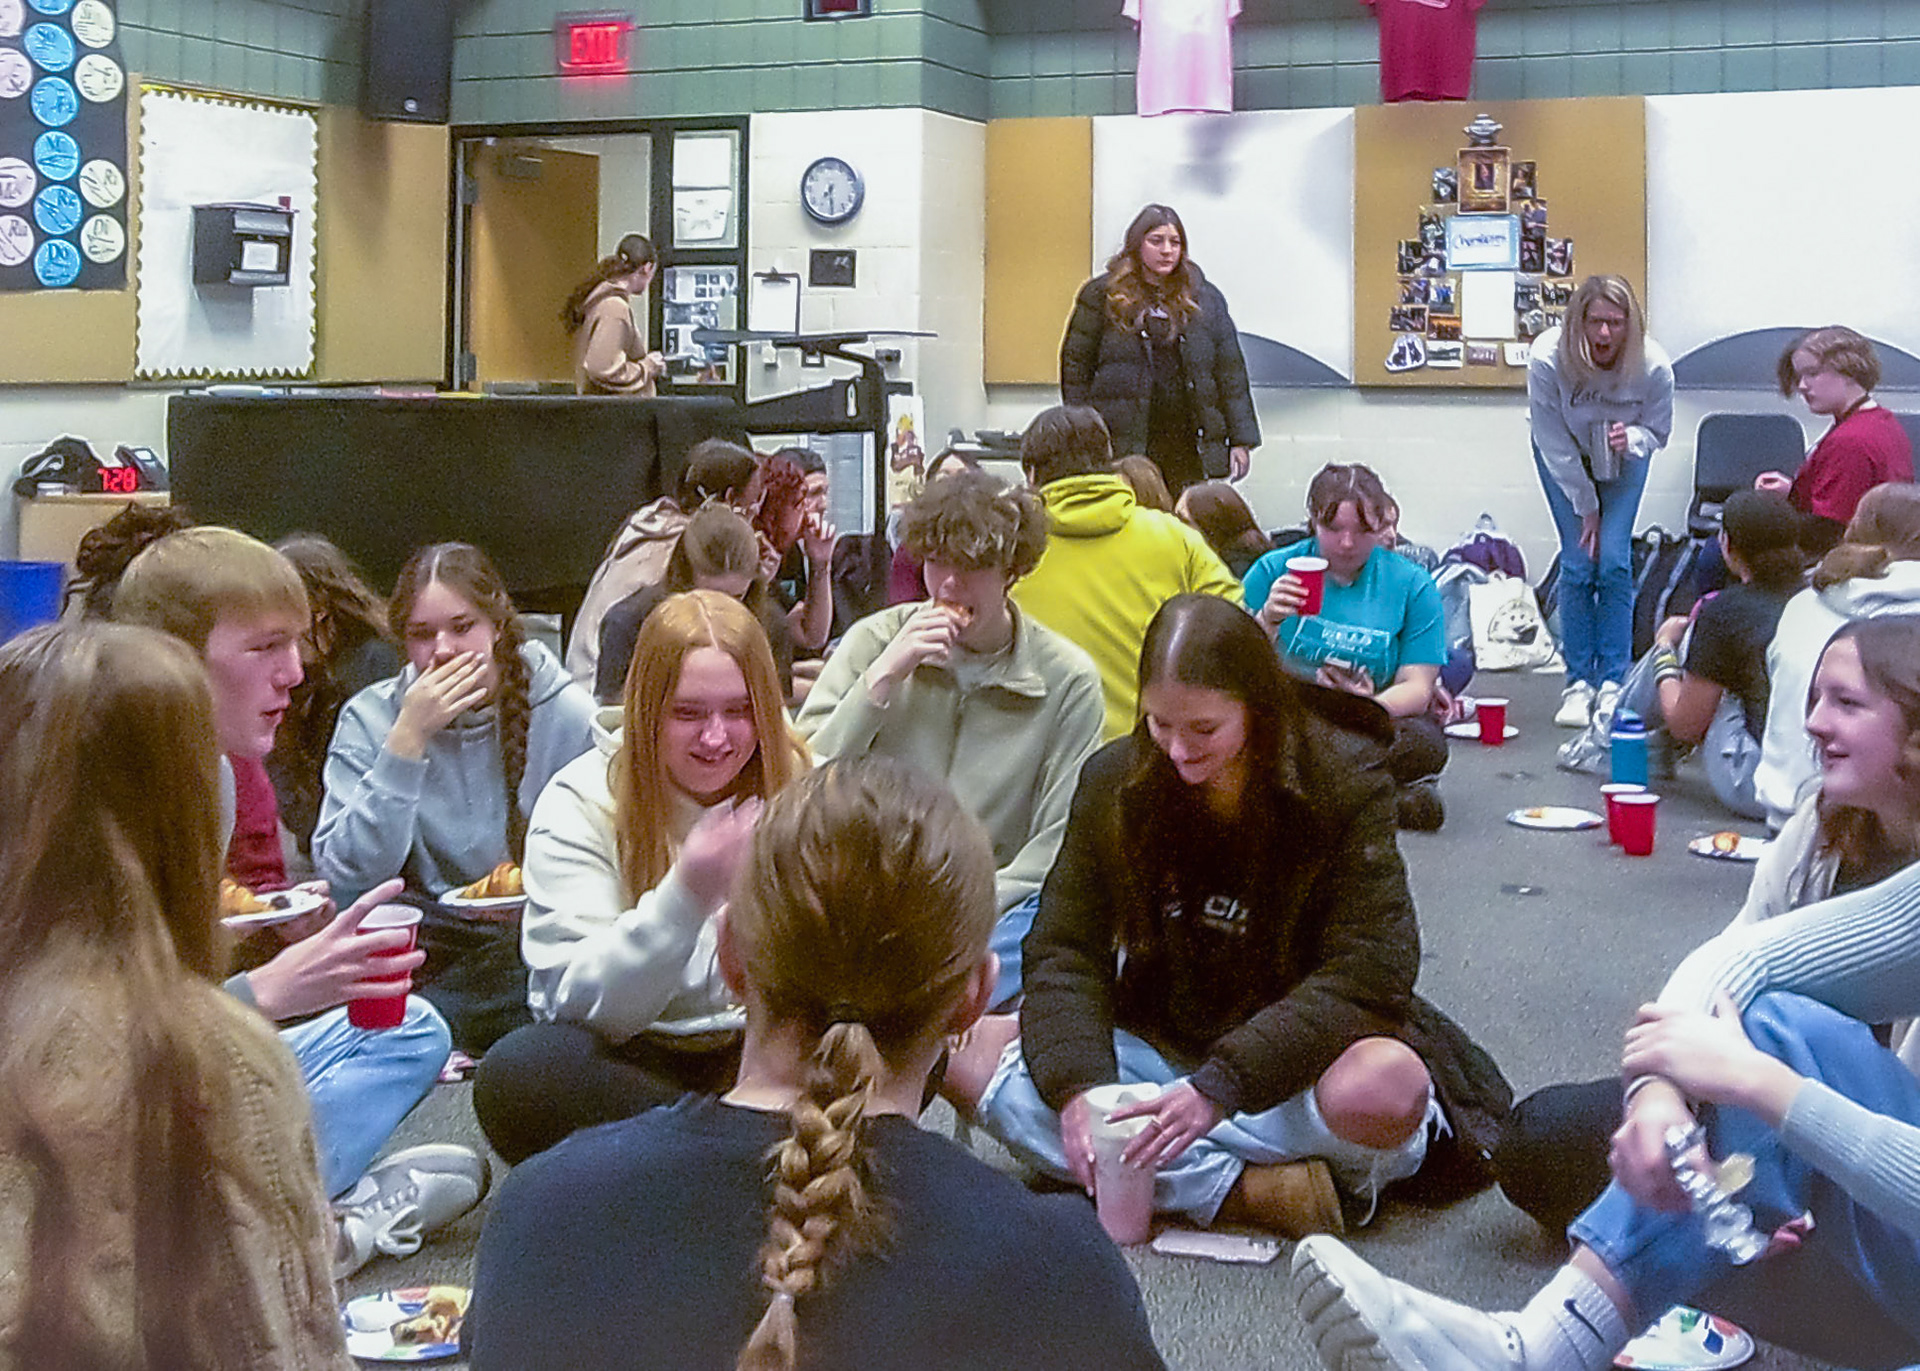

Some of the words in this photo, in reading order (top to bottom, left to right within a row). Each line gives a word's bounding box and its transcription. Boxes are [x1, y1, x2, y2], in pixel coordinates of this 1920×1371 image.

[571, 27, 618, 63] EXIT
[93, 218, 109, 236] Di
[48, 243, 69, 260] Do
